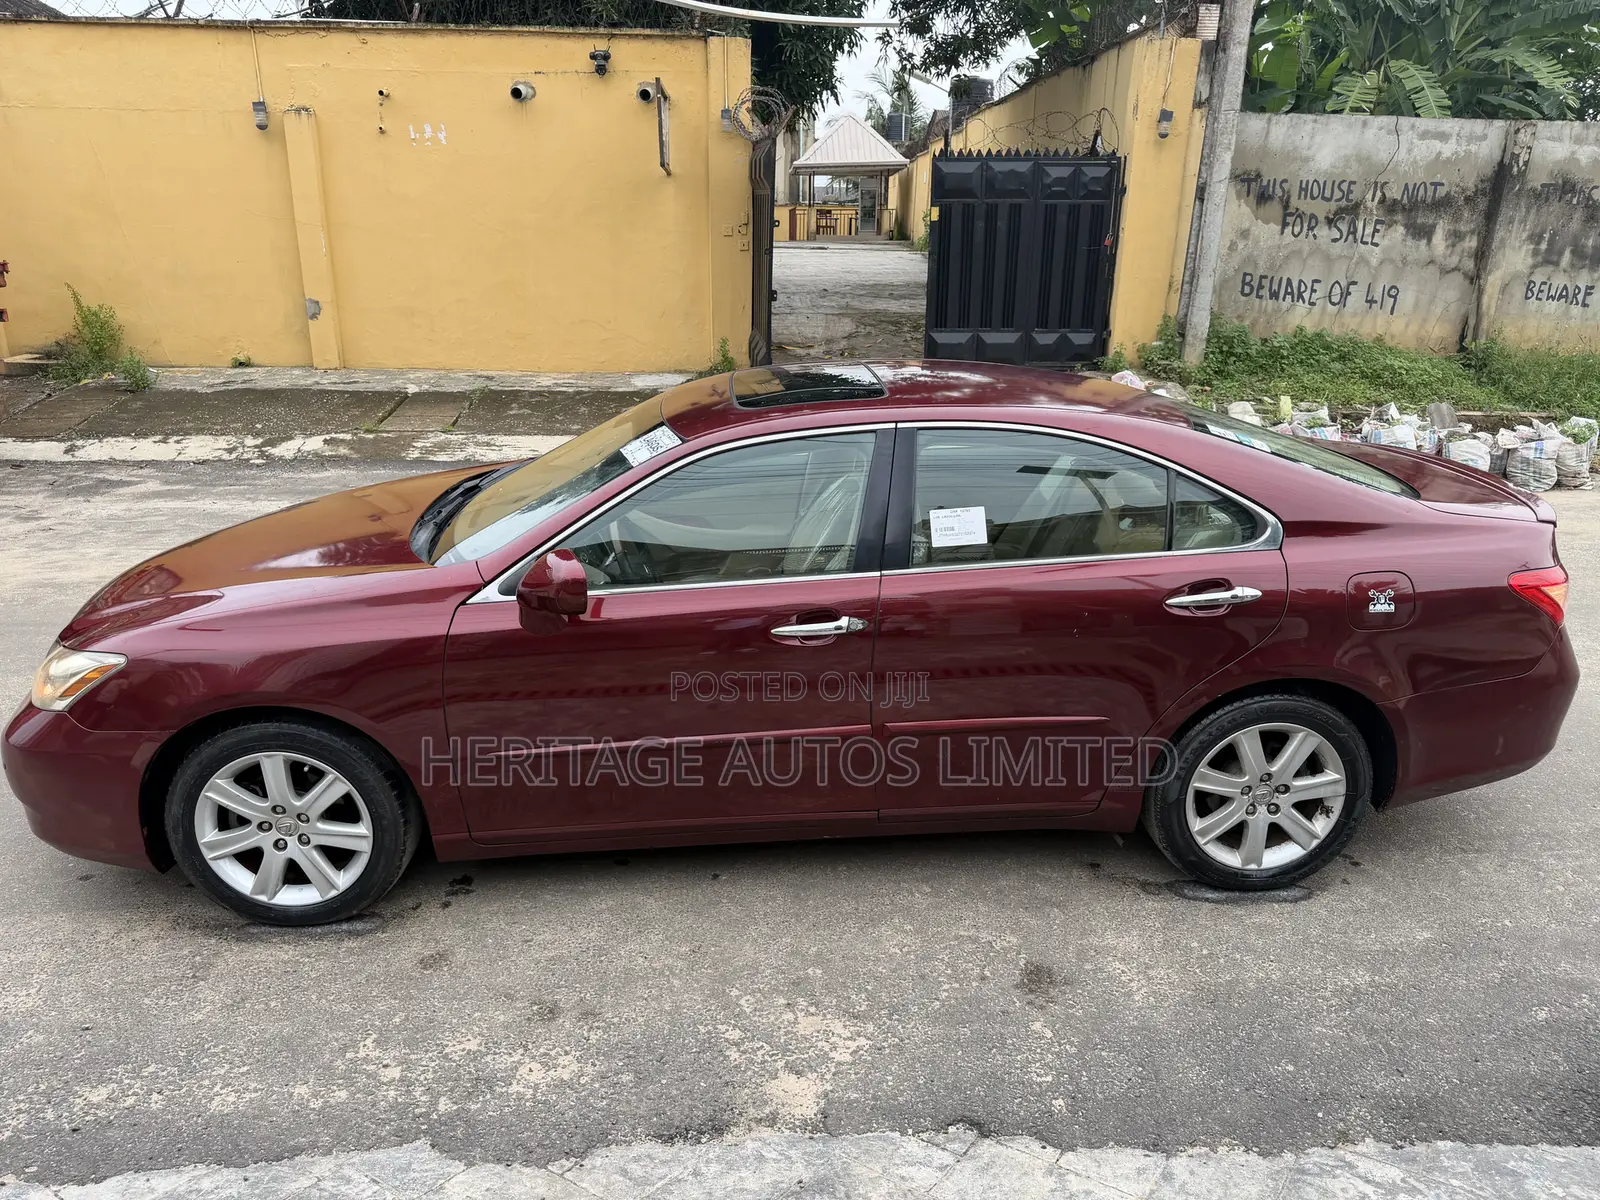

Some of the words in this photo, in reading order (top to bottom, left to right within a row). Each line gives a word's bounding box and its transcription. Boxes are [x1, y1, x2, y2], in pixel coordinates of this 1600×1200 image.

[1240, 178, 1288, 202] THIS
[1298, 179, 1357, 203] HOUSE
[1371, 181, 1389, 204] IS
[1401, 181, 1445, 202] NOT
[1281, 211, 1319, 240] FOR
[1331, 215, 1385, 247] SALE
[1240, 272, 1321, 306] BEWARE
[1328, 280, 1358, 309] OF
[1365, 282, 1400, 315] 419
[1525, 280, 1595, 308] BEWARE
